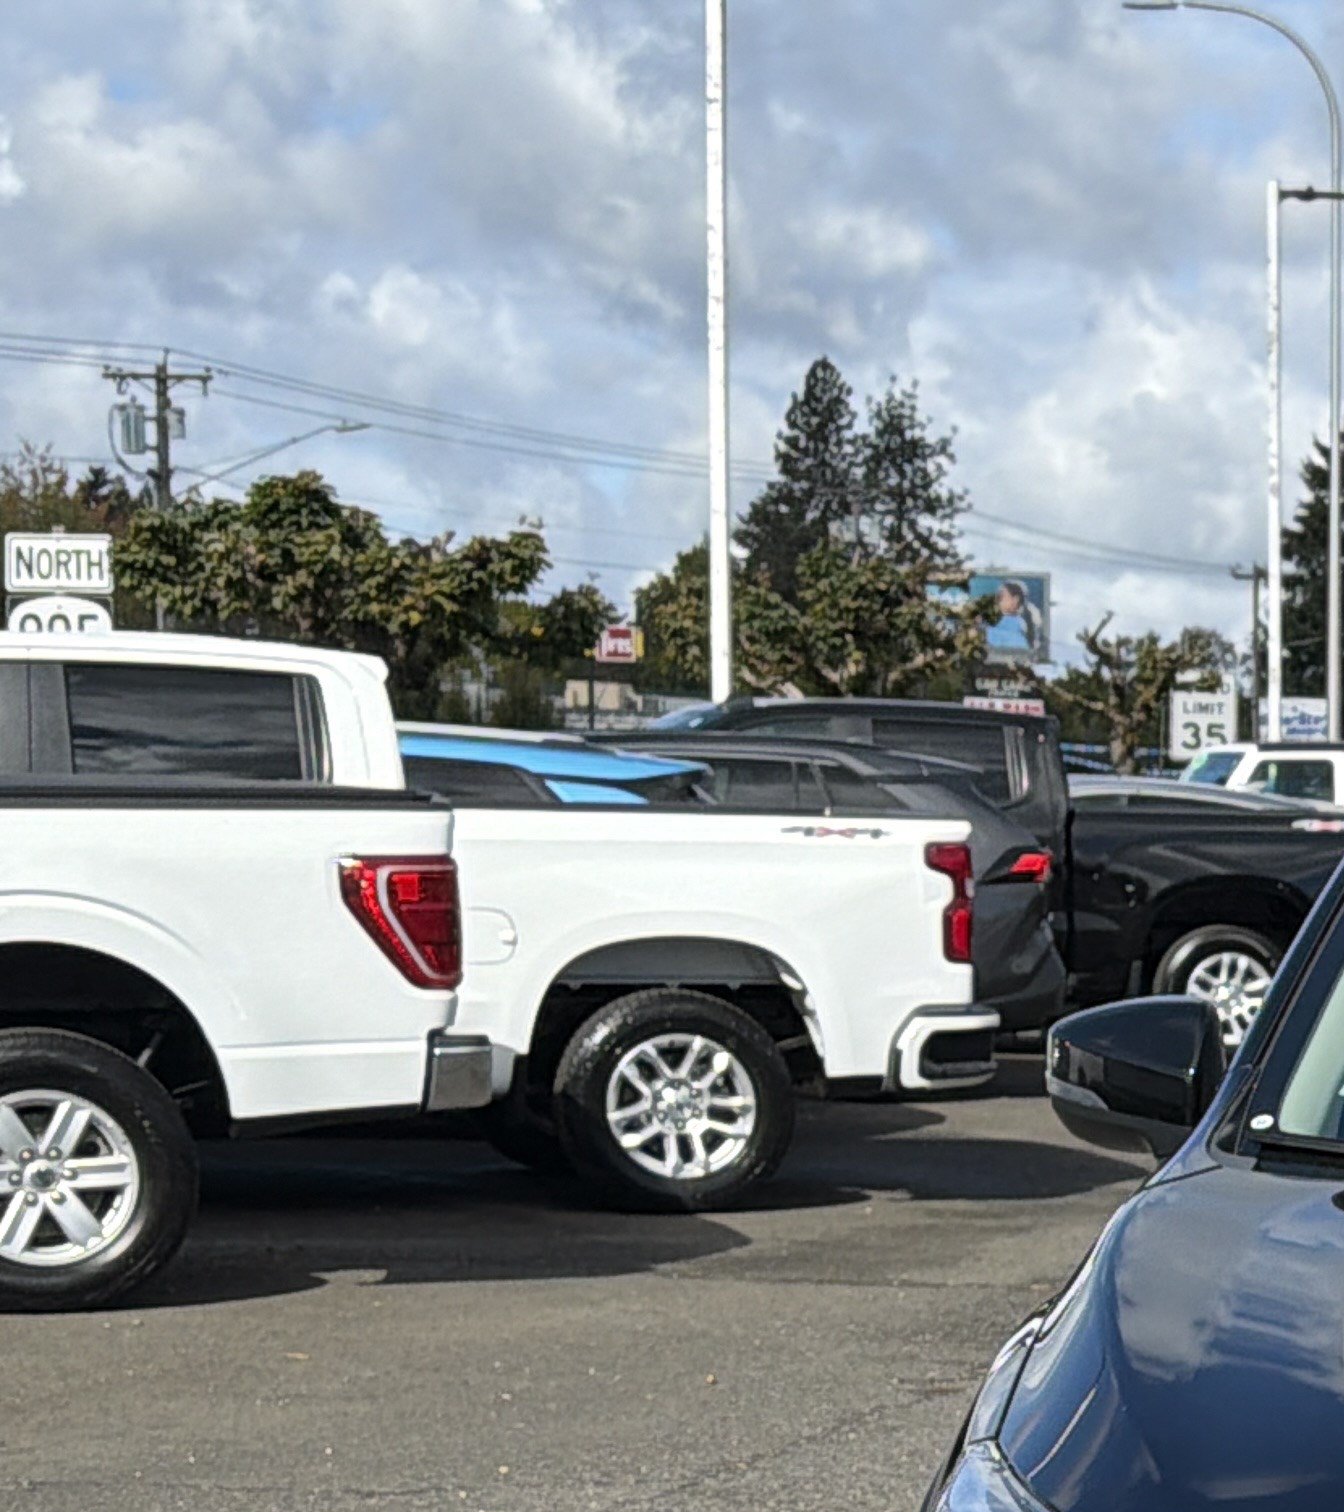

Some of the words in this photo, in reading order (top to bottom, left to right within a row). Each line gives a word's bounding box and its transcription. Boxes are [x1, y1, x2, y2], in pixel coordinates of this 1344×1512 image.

[15, 546, 104, 580] NORTH
[1182, 701, 1224, 715] LIMIT
[1181, 721, 1228, 749] 35
